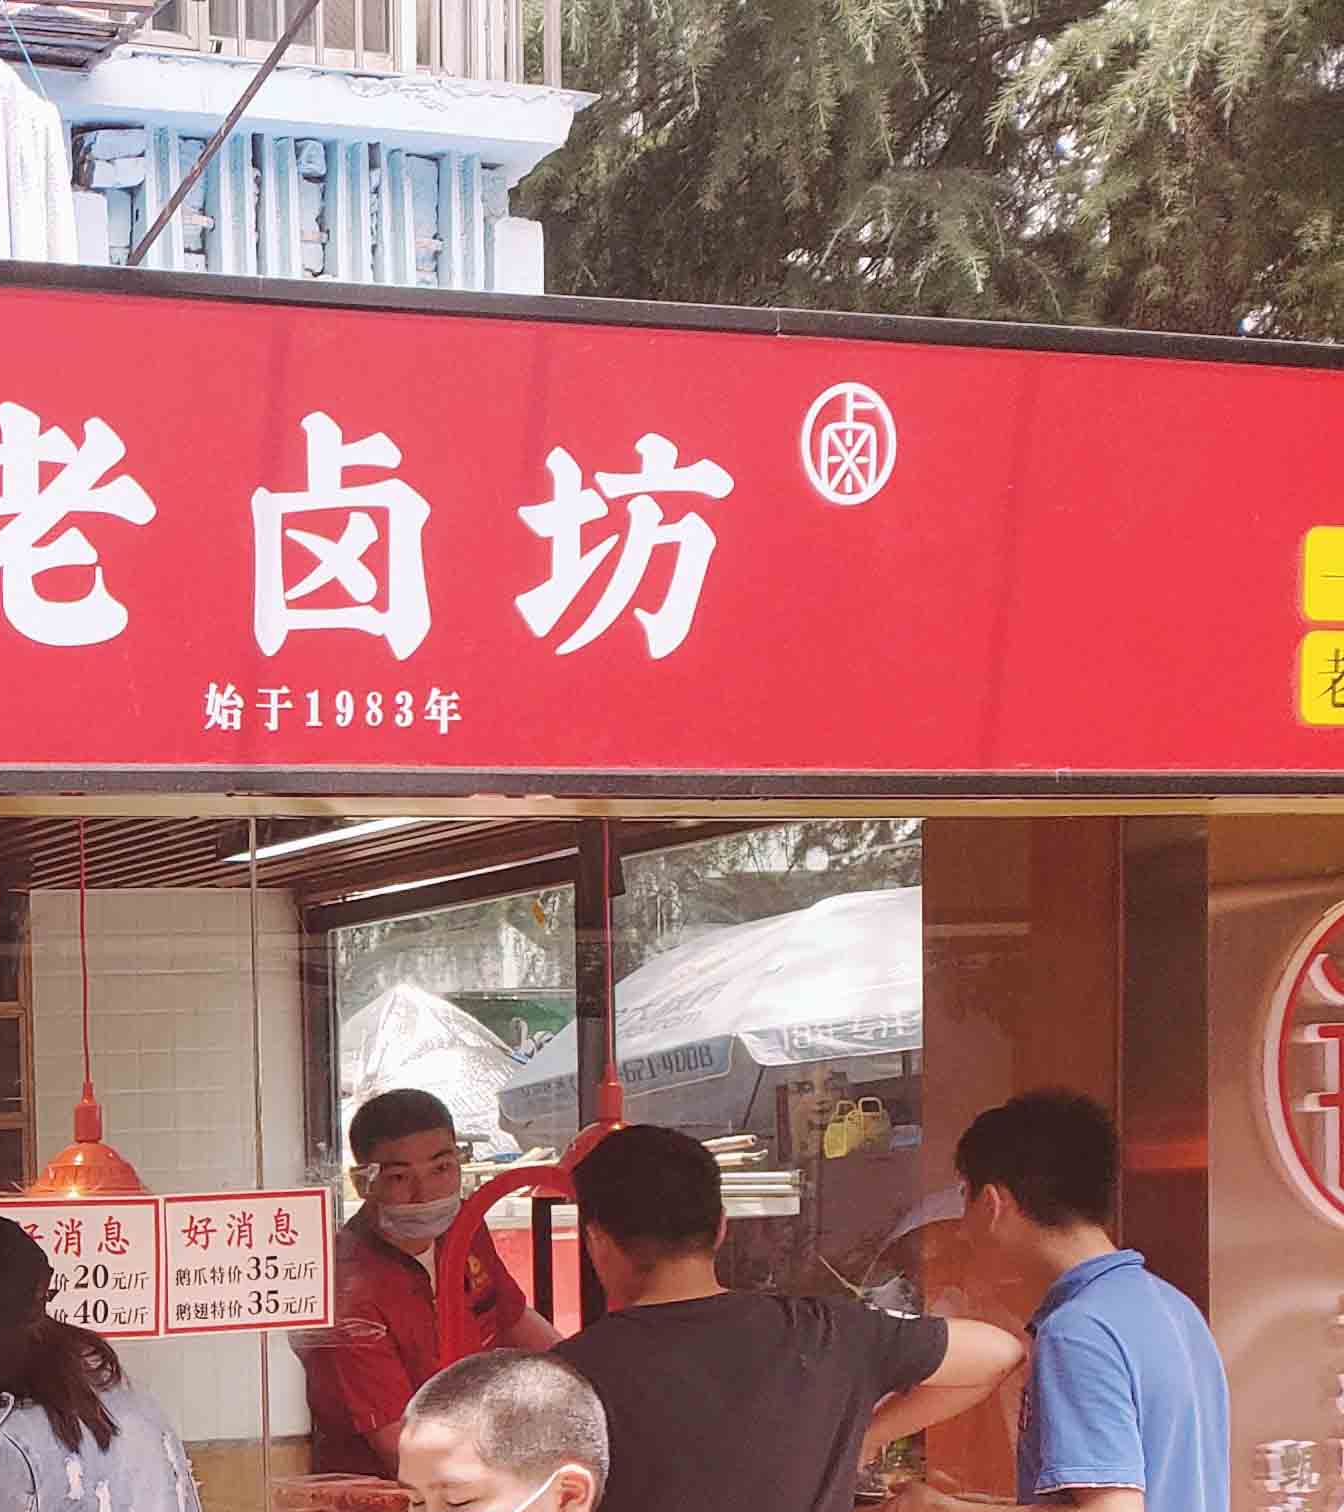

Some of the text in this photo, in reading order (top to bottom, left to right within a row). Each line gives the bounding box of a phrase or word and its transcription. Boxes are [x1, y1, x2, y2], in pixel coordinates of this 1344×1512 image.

[203, 682, 463, 734] 始于1983年
[181, 1206, 300, 1252] 好消息
[175, 1254, 318, 1288] 鹅爪特价35元/斤
[175, 1289, 319, 1322] 鹅翅特价35元/斤
